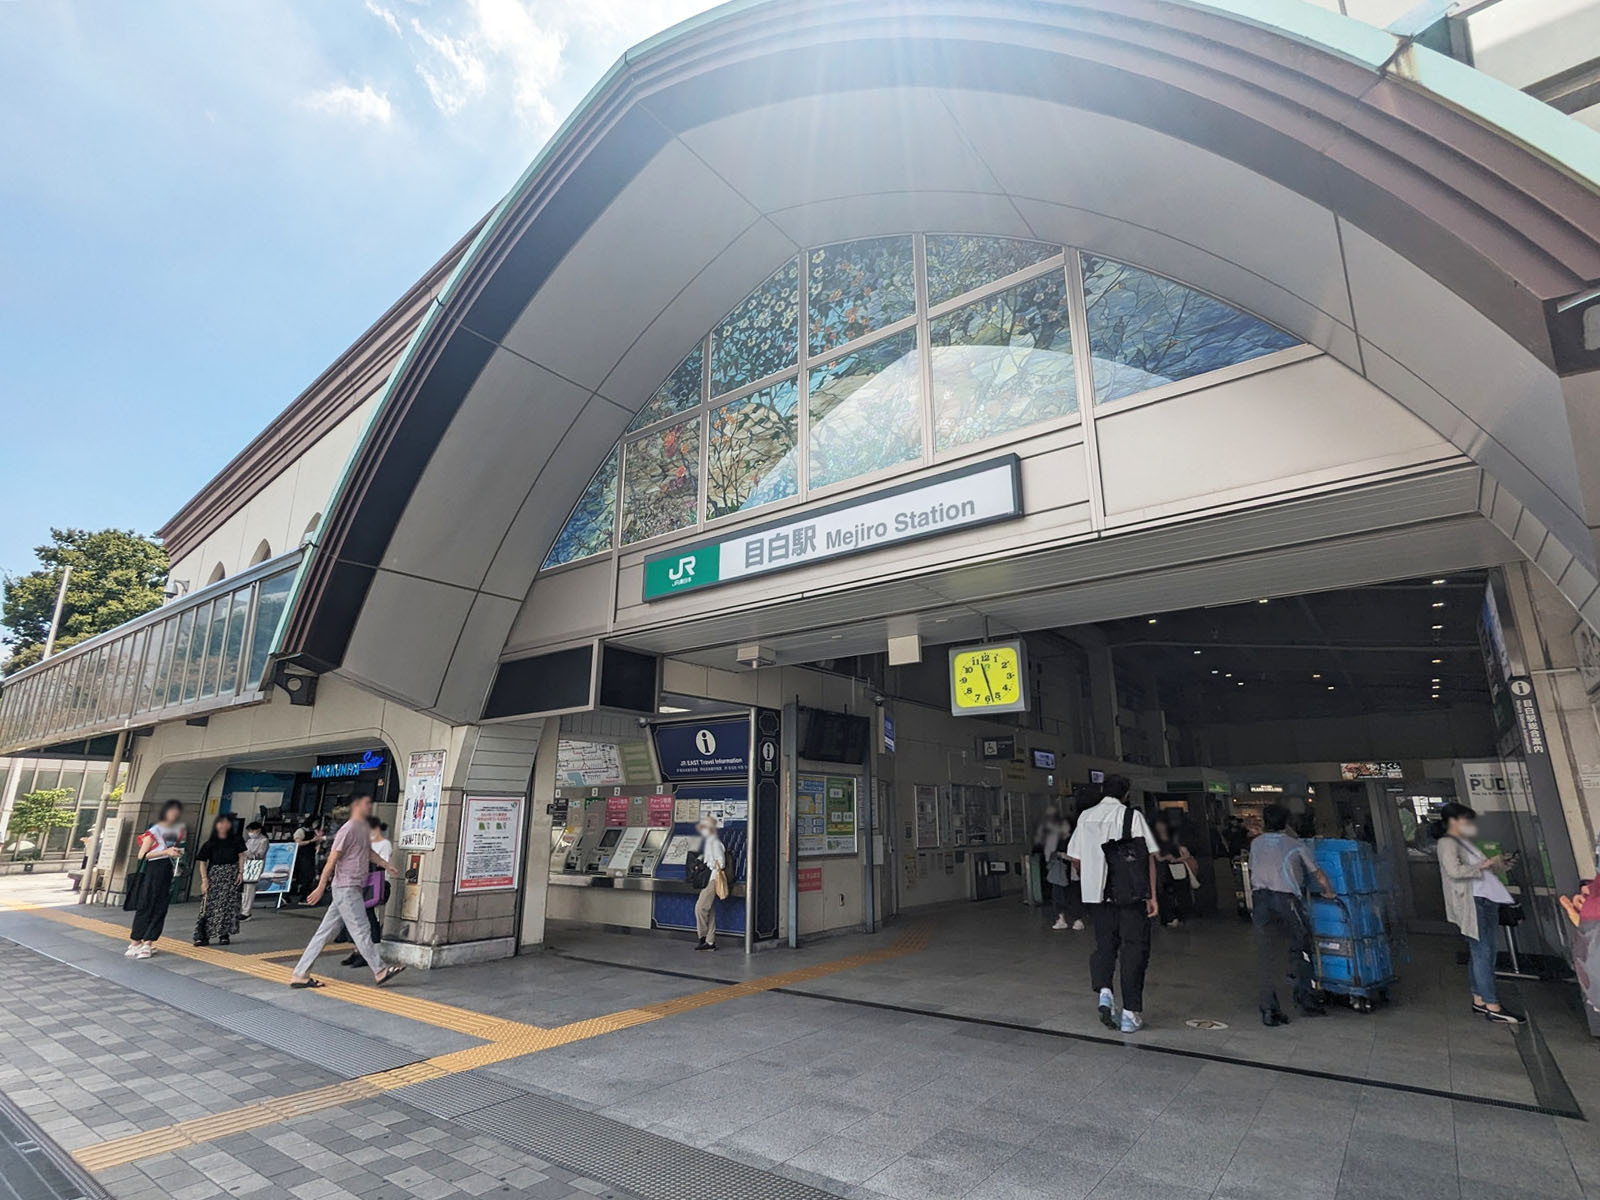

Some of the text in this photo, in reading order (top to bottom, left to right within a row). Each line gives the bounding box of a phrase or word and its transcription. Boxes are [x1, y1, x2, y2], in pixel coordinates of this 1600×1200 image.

[745, 497, 976, 569] 目白駅 Mejiro Station
[669, 556, 696, 580] JR
[981, 654, 990, 662] 12
[994, 655, 998, 663] 1
[1001, 661, 1007, 669] 2
[965, 666, 974, 674] 10
[961, 676, 968, 684] 9
[1006, 672, 1013, 680] 3
[975, 693, 981, 701] 7
[984, 694, 991, 702] 6
[715, 757, 743, 765] Information
